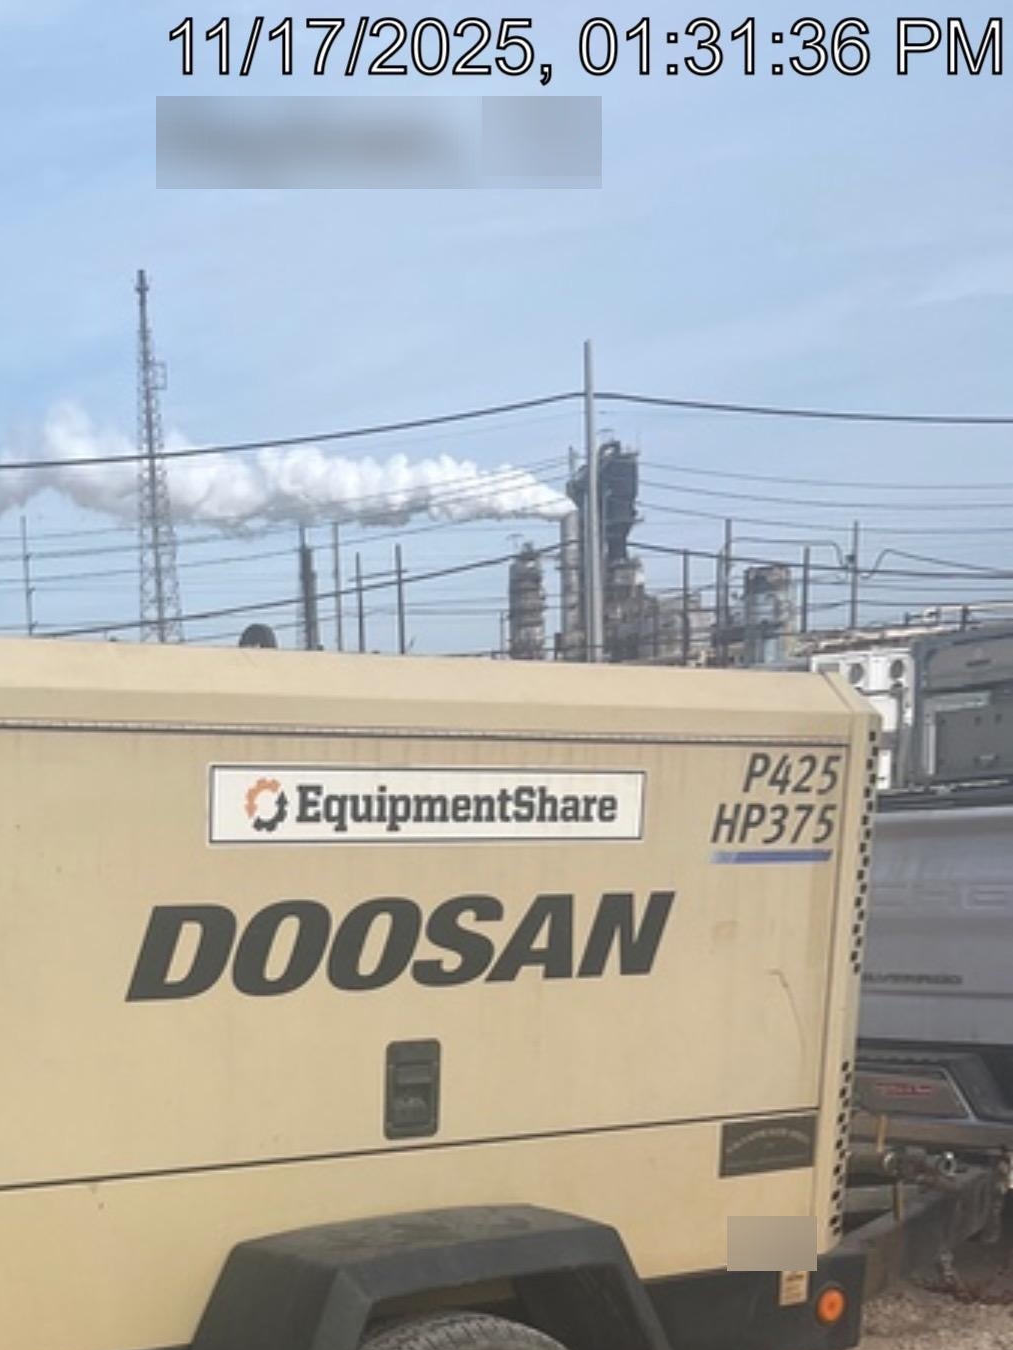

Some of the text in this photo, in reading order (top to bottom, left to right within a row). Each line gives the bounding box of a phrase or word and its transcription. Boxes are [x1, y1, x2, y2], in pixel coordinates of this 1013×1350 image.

[743, 753, 841, 795] P425
[296, 785, 617, 832] EquipmentShare
[711, 803, 837, 844] HP375
[124, 891, 675, 1003] DOOSAN
